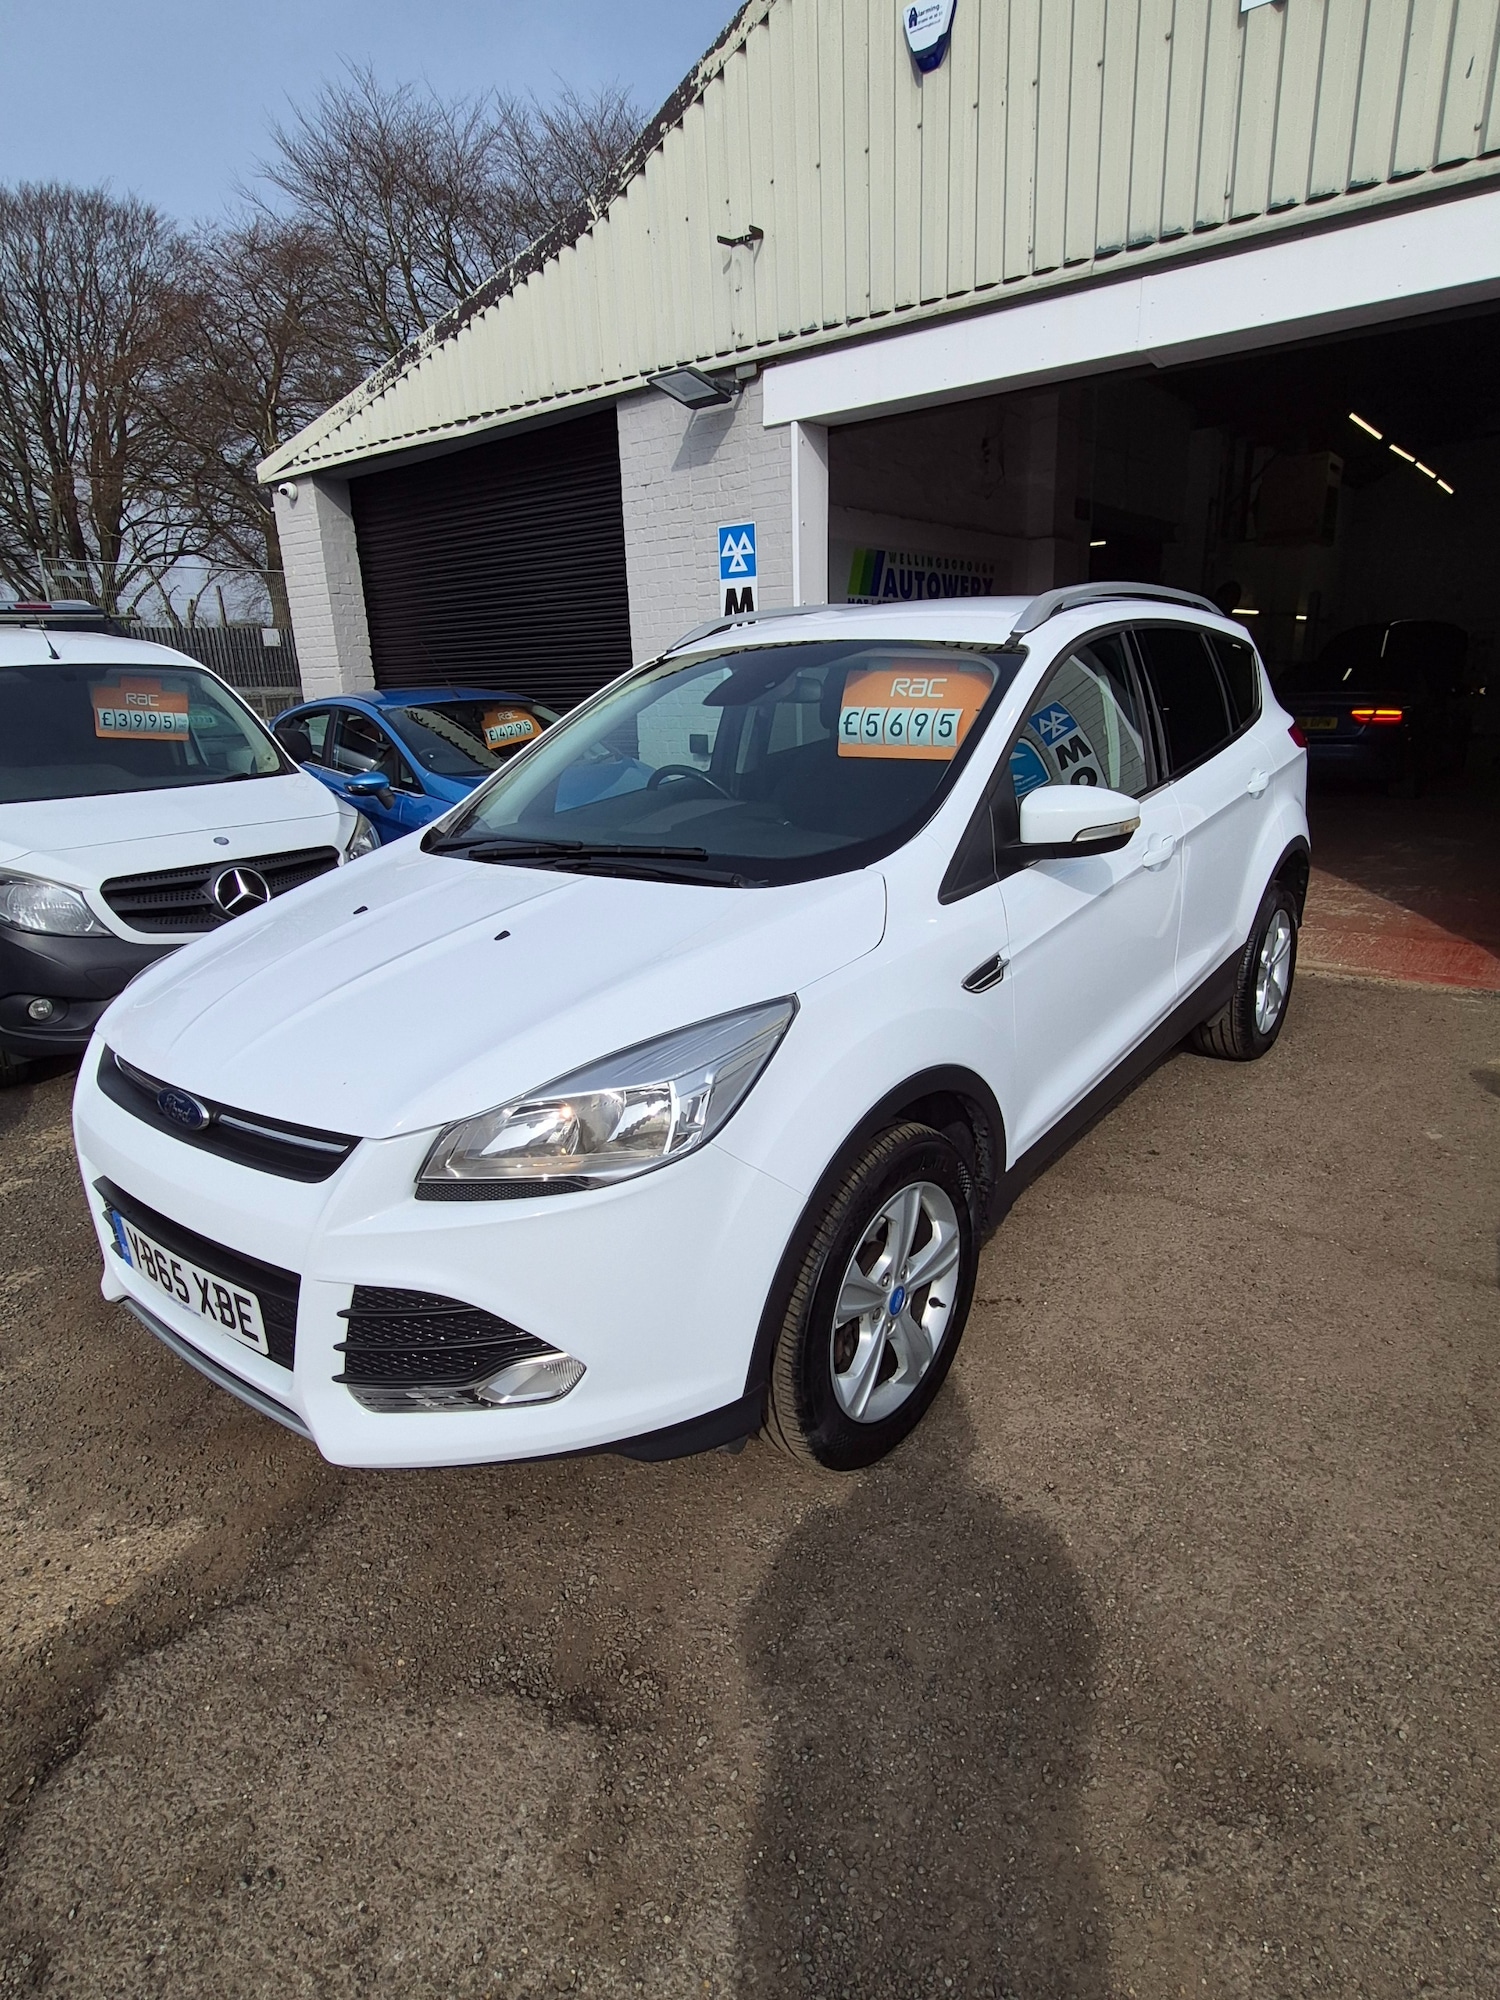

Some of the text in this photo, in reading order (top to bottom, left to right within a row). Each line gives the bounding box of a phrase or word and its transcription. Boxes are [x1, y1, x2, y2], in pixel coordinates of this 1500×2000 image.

[888, 551, 995, 574] WELLINGBOROUGH
[101, 712, 172, 729] £3995
[488, 721, 532, 741] £4295
[843, 711, 956, 738] £5695
[126, 1226, 260, 1343] YB65 XBE
